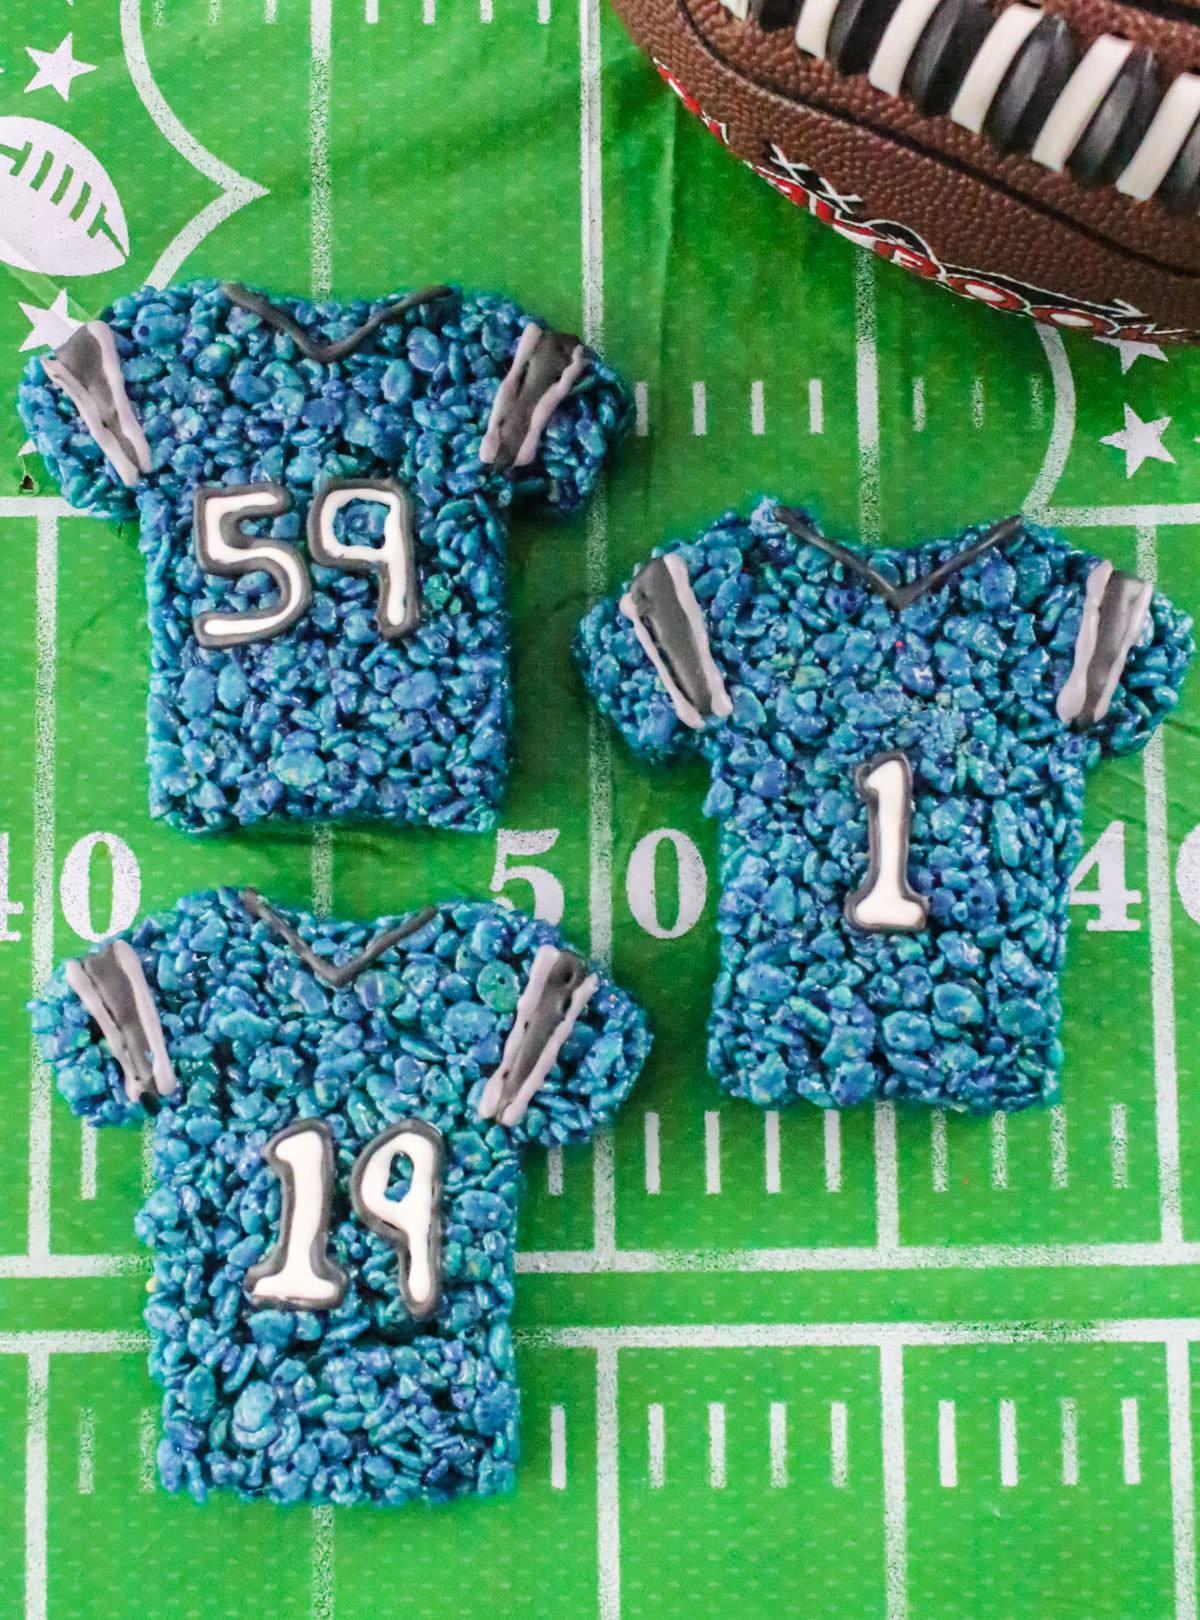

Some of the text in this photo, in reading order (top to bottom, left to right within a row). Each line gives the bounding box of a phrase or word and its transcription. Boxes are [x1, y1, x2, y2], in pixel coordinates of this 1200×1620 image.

[194, 479, 419, 650] 59
[845, 752, 929, 932] 1
[245, 1118, 443, 1317] 19
